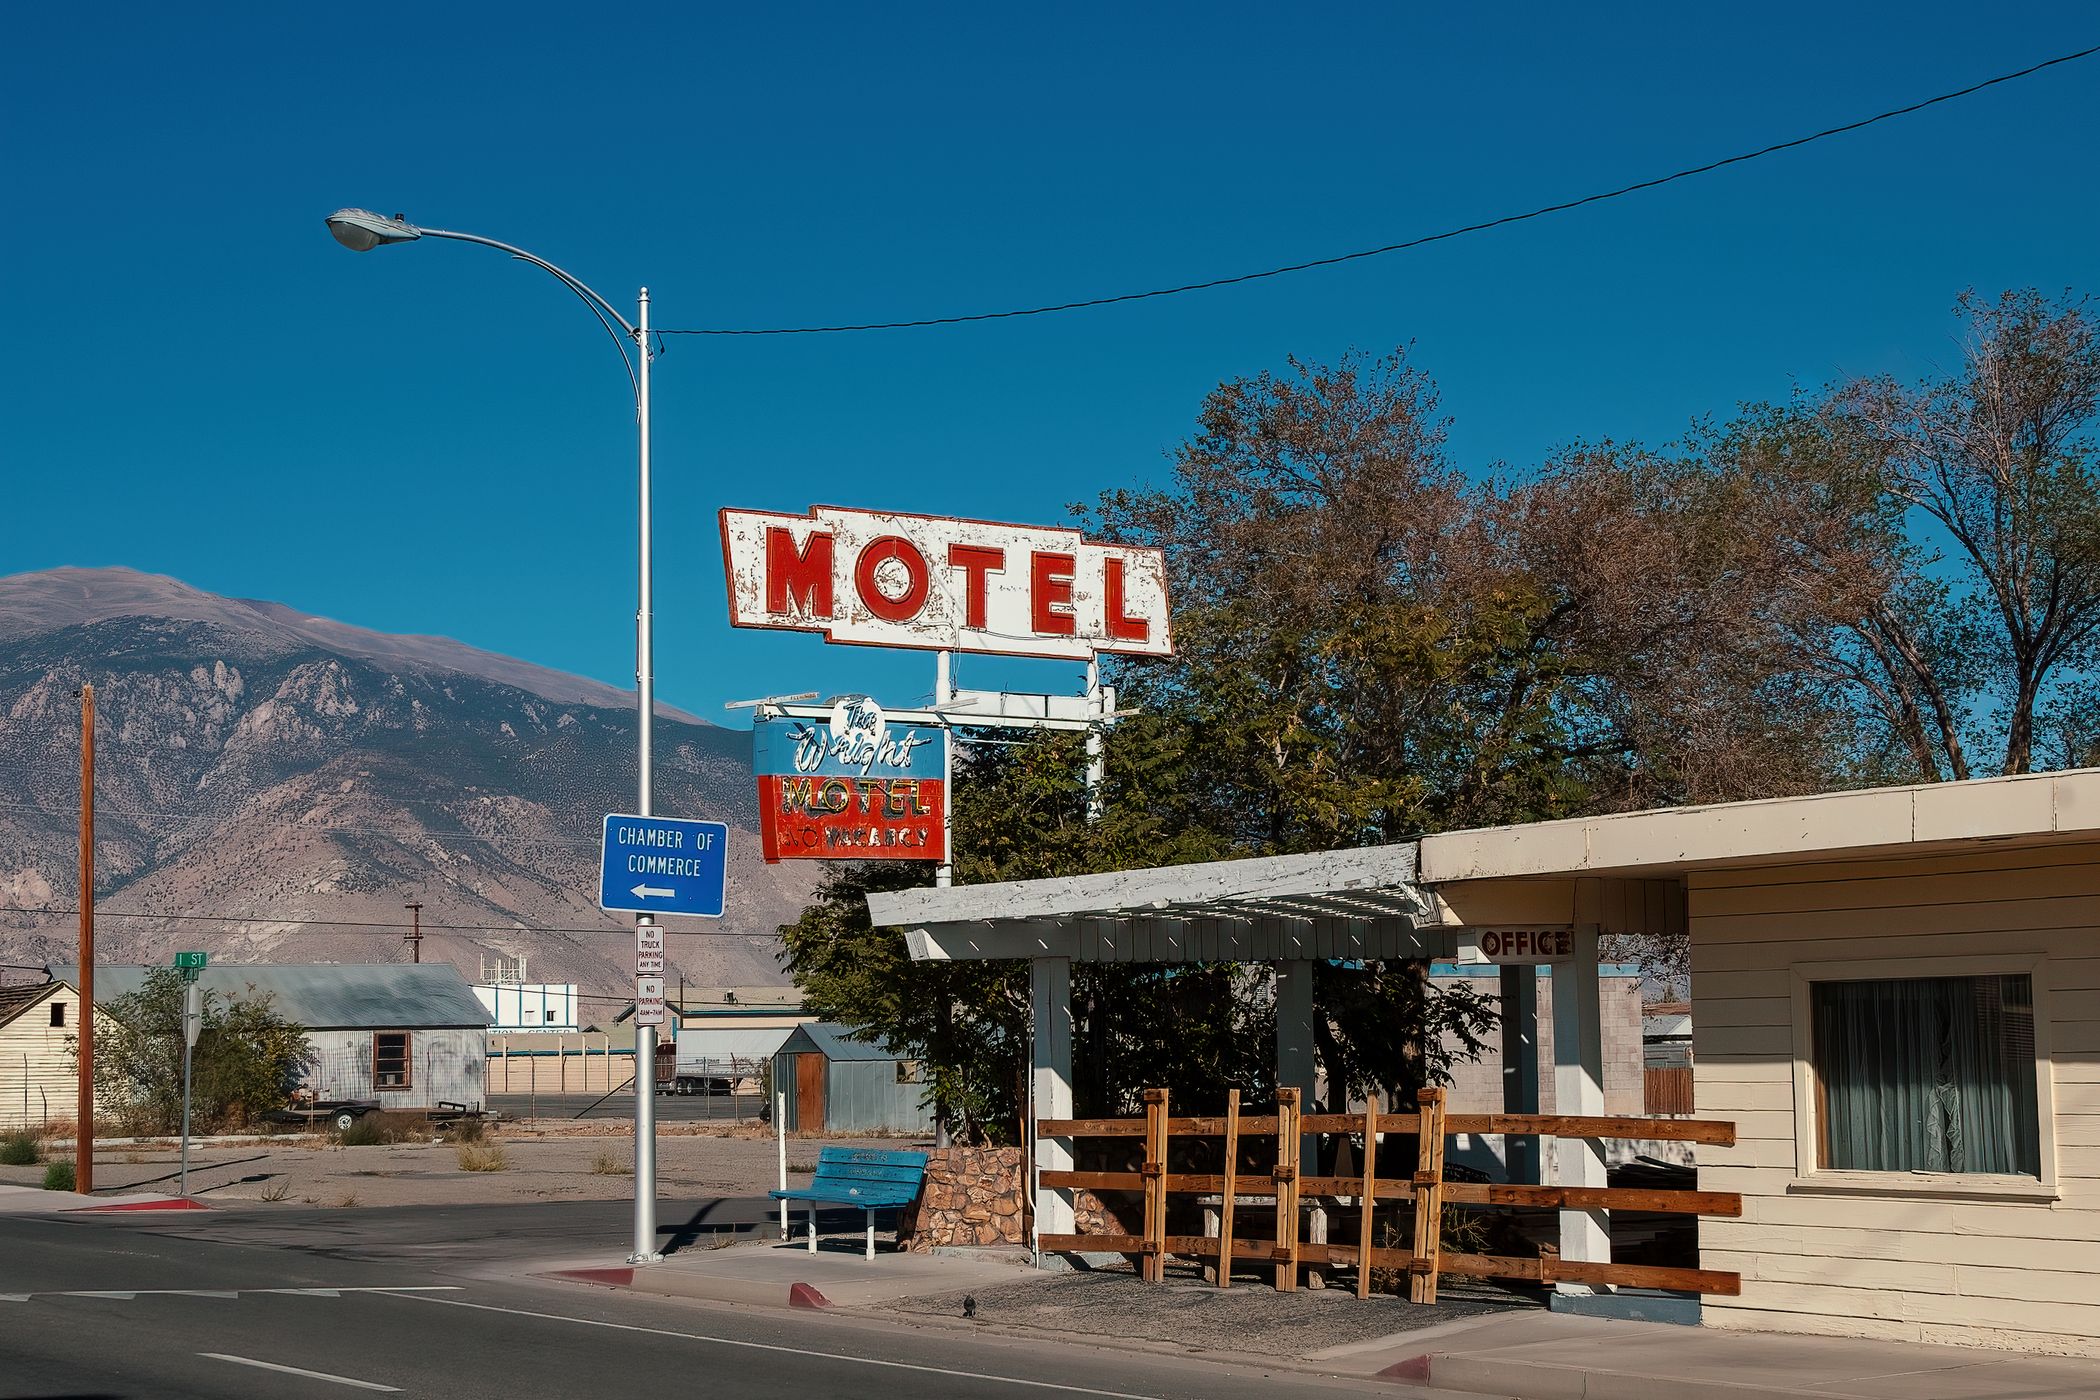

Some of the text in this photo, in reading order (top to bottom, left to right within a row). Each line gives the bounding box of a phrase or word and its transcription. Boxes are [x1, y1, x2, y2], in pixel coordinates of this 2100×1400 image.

[765, 526, 1149, 643] MOTEL
[843, 699, 878, 733] The
[786, 726, 932, 776] Wright
[782, 776, 930, 816] MOTEL
[618, 826, 714, 851] CHAMBER OF
[824, 826, 929, 849] VACANCY
[628, 854, 701, 877] COMMERCE
[640, 940, 660, 949] TRUCK
[645, 930, 655, 938] NO
[1481, 931, 1570, 956] OFFICE
[191, 953, 203, 965] ST
[638, 951, 663, 960] PARKING
[646, 985, 655, 994] NO
[638, 997, 663, 1006] PARKING
